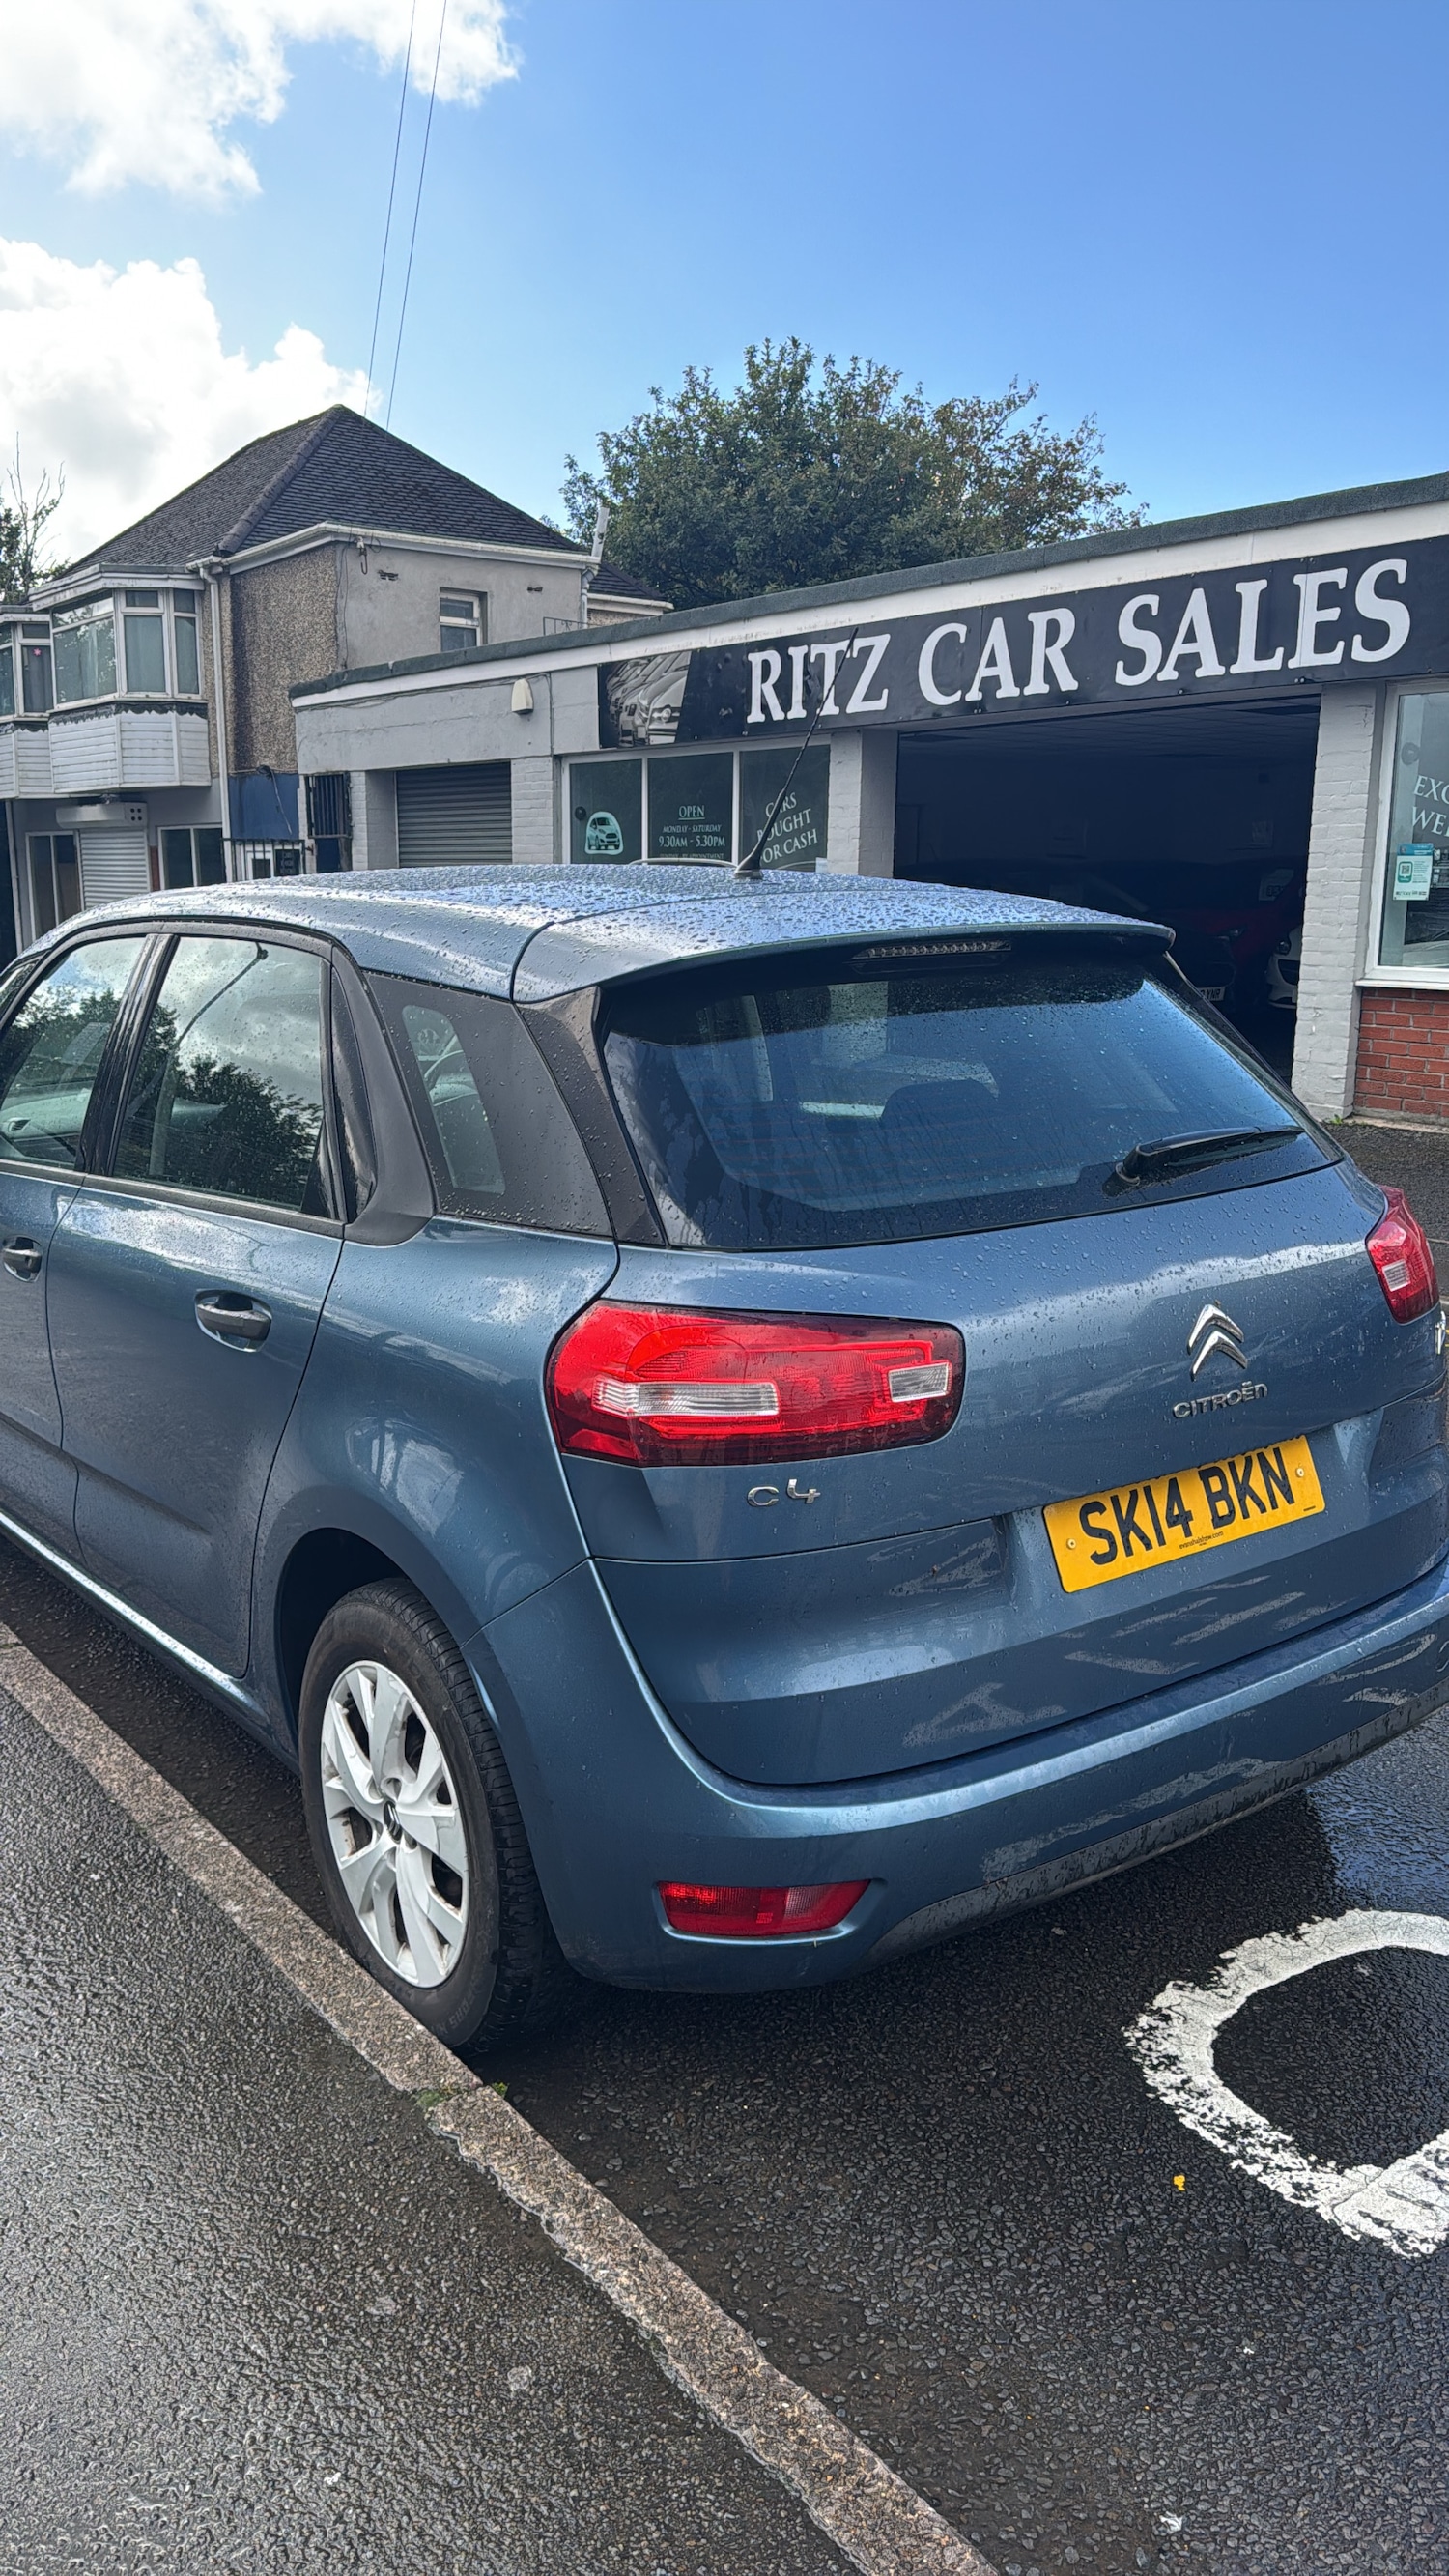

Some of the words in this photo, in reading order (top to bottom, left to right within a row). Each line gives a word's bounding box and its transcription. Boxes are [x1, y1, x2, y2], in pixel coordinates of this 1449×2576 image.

[747, 633, 891, 724] RITZ
[918, 608, 1078, 706] CAR
[1115, 558, 1412, 687] SALES
[678, 805, 705, 818] OPEN
[765, 792, 797, 817] CRS
[692, 824, 722, 833] SATURDAY
[1412, 806, 1449, 837] WE
[658, 835, 688, 847] 9.30AM
[696, 835, 725, 847] 5.30PM
[760, 844, 782, 867] OR
[783, 828, 818, 855] CASH
[746, 1478, 821, 1507] C4
[1079, 1476, 1194, 1565] SK14
[1197, 1446, 1295, 1529] BKN
